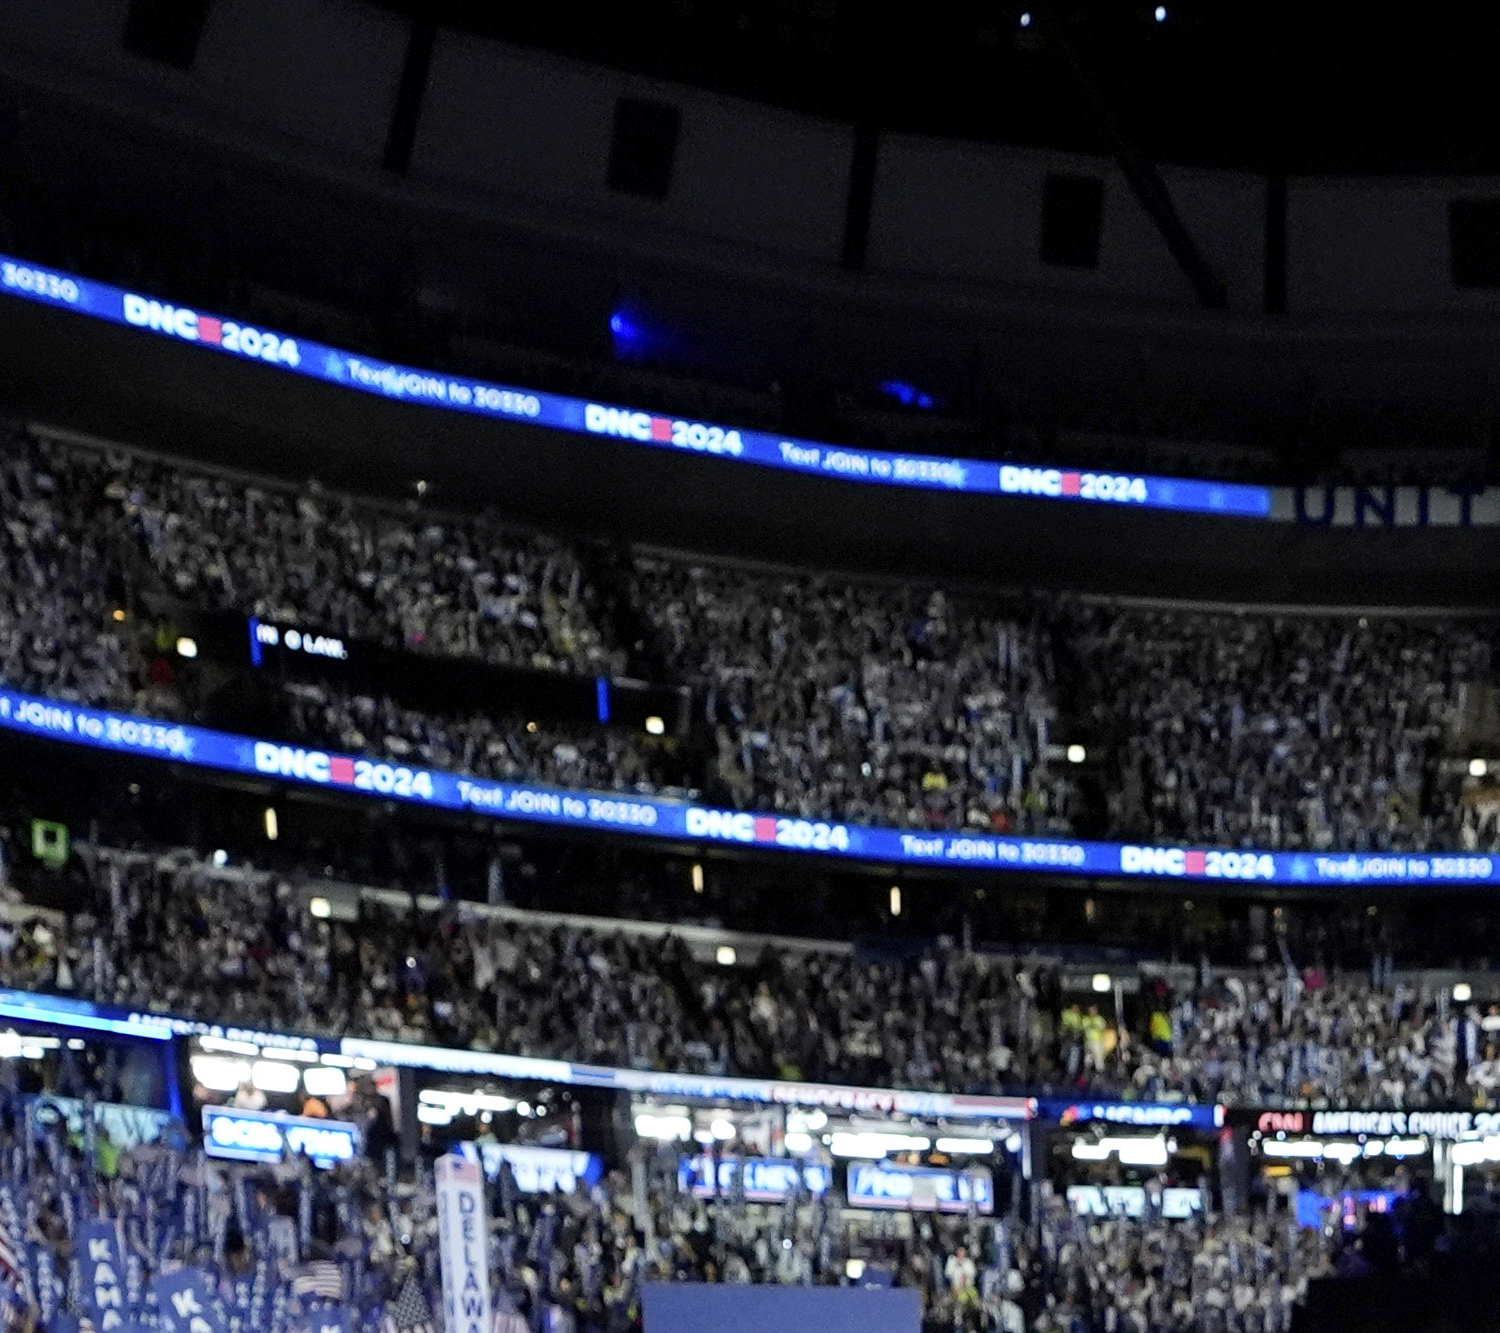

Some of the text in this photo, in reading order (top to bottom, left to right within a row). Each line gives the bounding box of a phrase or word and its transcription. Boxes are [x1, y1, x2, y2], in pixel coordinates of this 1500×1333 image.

[124, 294, 300, 366] DNC 2024
[586, 404, 743, 454] DNC 2024
[1000, 466, 1147, 502] DNC 2024
[255, 742, 434, 798] DNC 2024
[686, 808, 849, 850] DNC 2024
[1121, 846, 1275, 879] DNC 2024
